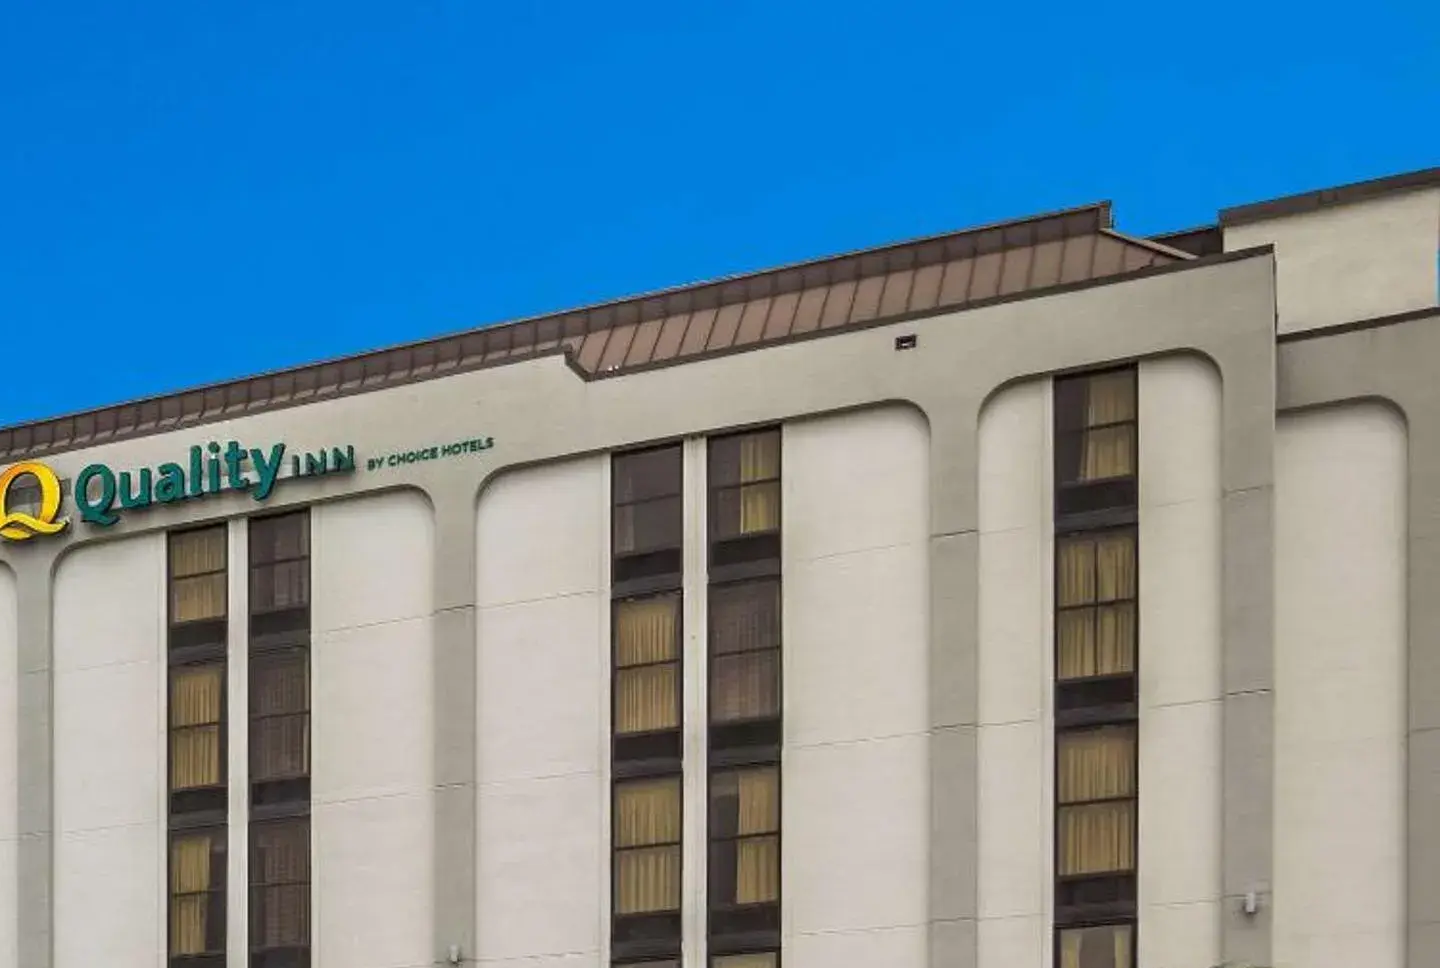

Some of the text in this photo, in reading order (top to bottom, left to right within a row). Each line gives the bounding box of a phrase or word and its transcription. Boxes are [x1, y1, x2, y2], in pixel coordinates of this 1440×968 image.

[74, 440, 356, 526] Quality INN
[367, 437, 495, 471] BY CHOICE HOTELS
